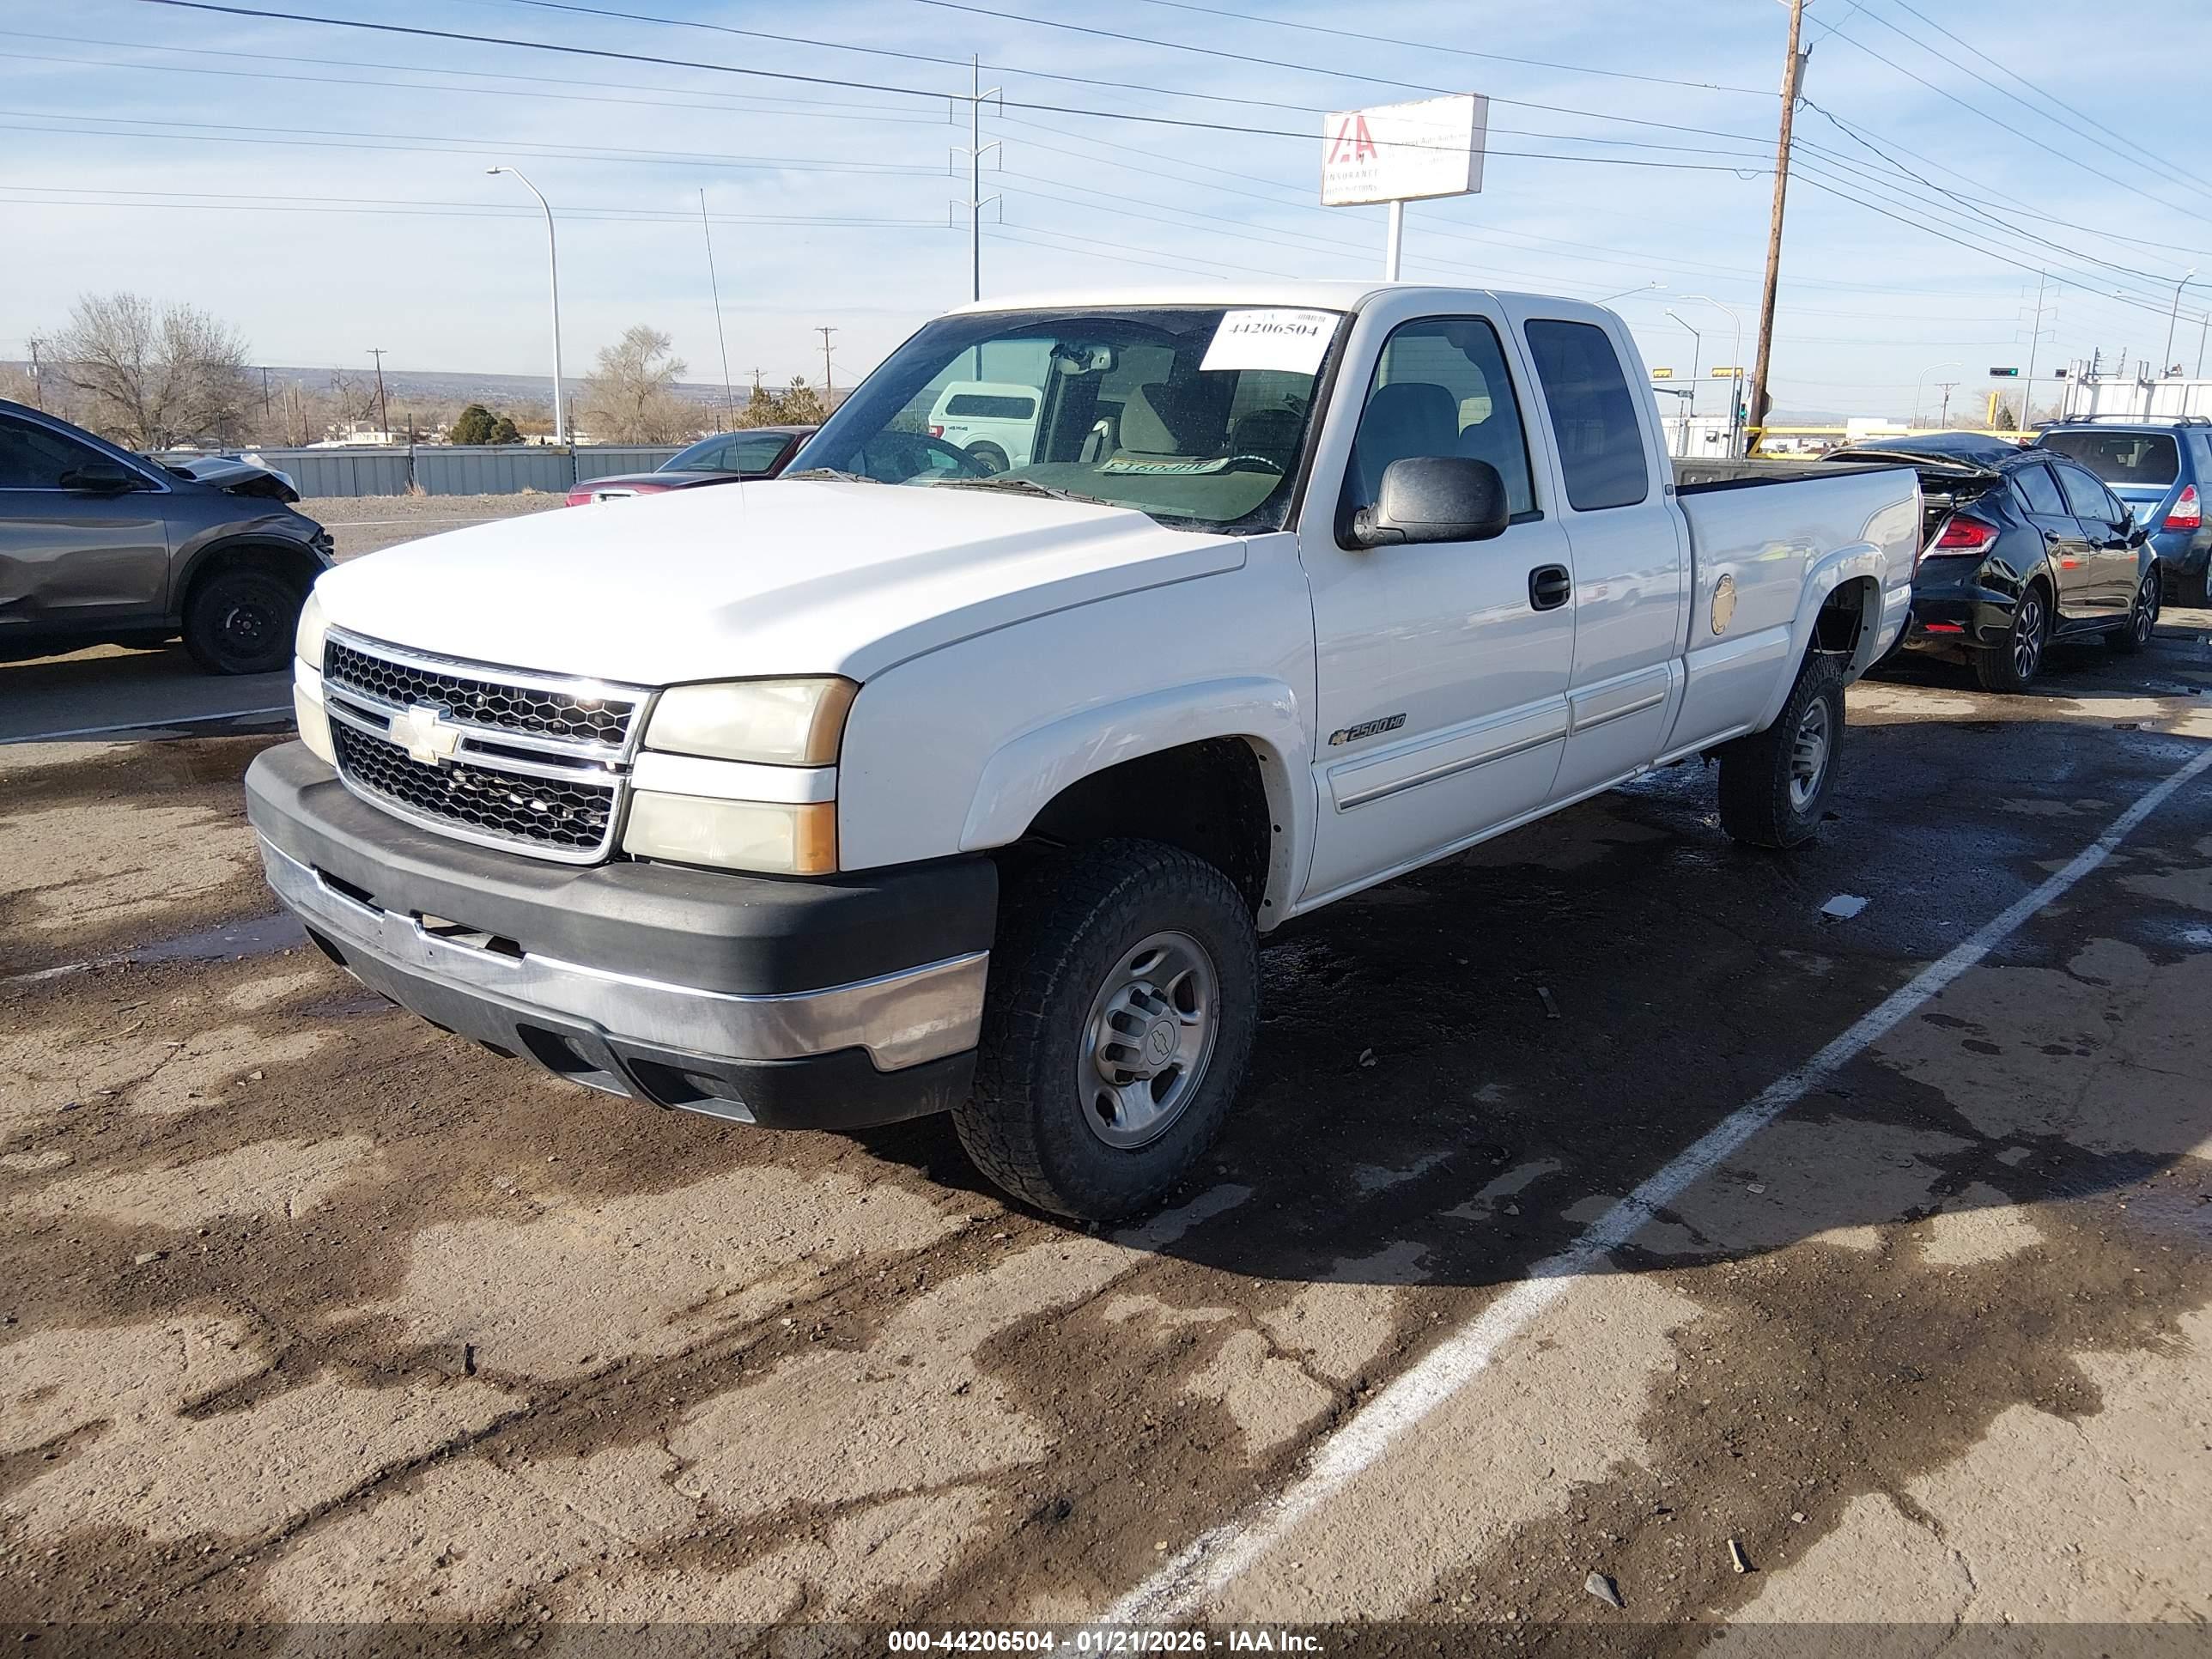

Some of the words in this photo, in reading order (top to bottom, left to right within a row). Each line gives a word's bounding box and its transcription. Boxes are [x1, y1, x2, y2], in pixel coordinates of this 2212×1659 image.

[1229, 323, 1319, 337] 44206504
[1349, 719, 1389, 740] 2500
[1389, 715, 1405, 728] HD
